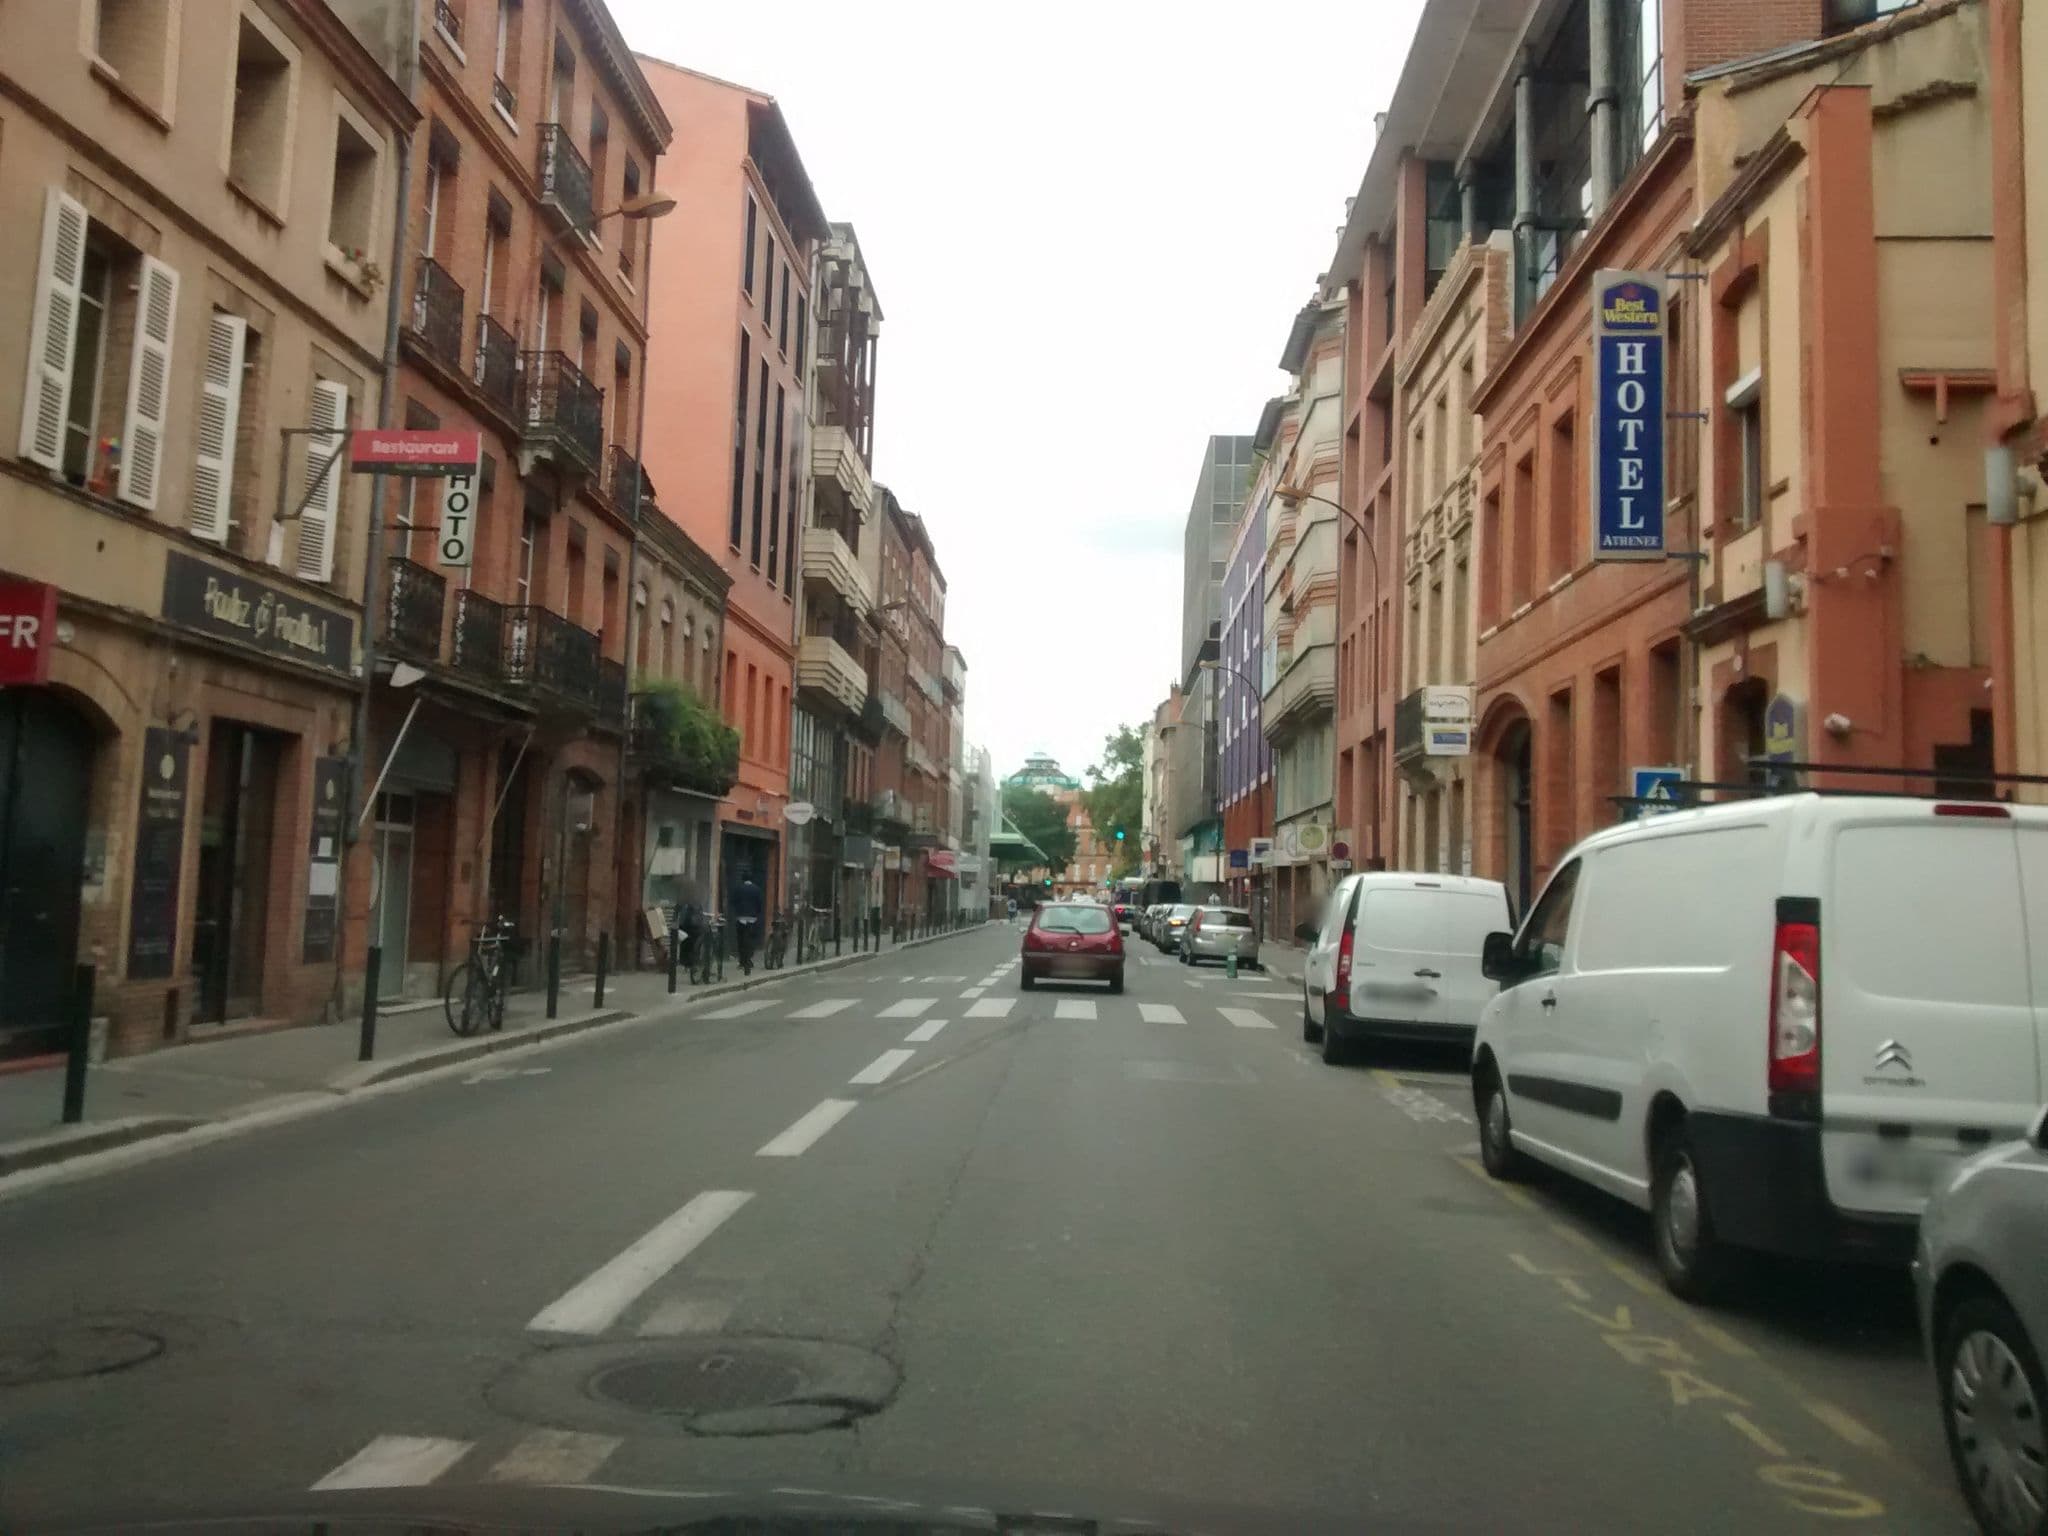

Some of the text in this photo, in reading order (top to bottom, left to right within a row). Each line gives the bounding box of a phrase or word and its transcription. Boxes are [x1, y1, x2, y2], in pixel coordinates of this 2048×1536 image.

[1615, 297, 1645, 312] Best
[1604, 309, 1659, 324] Western
[1616, 342, 1647, 530] HOTEL
[372, 440, 459, 455] Restaurant
